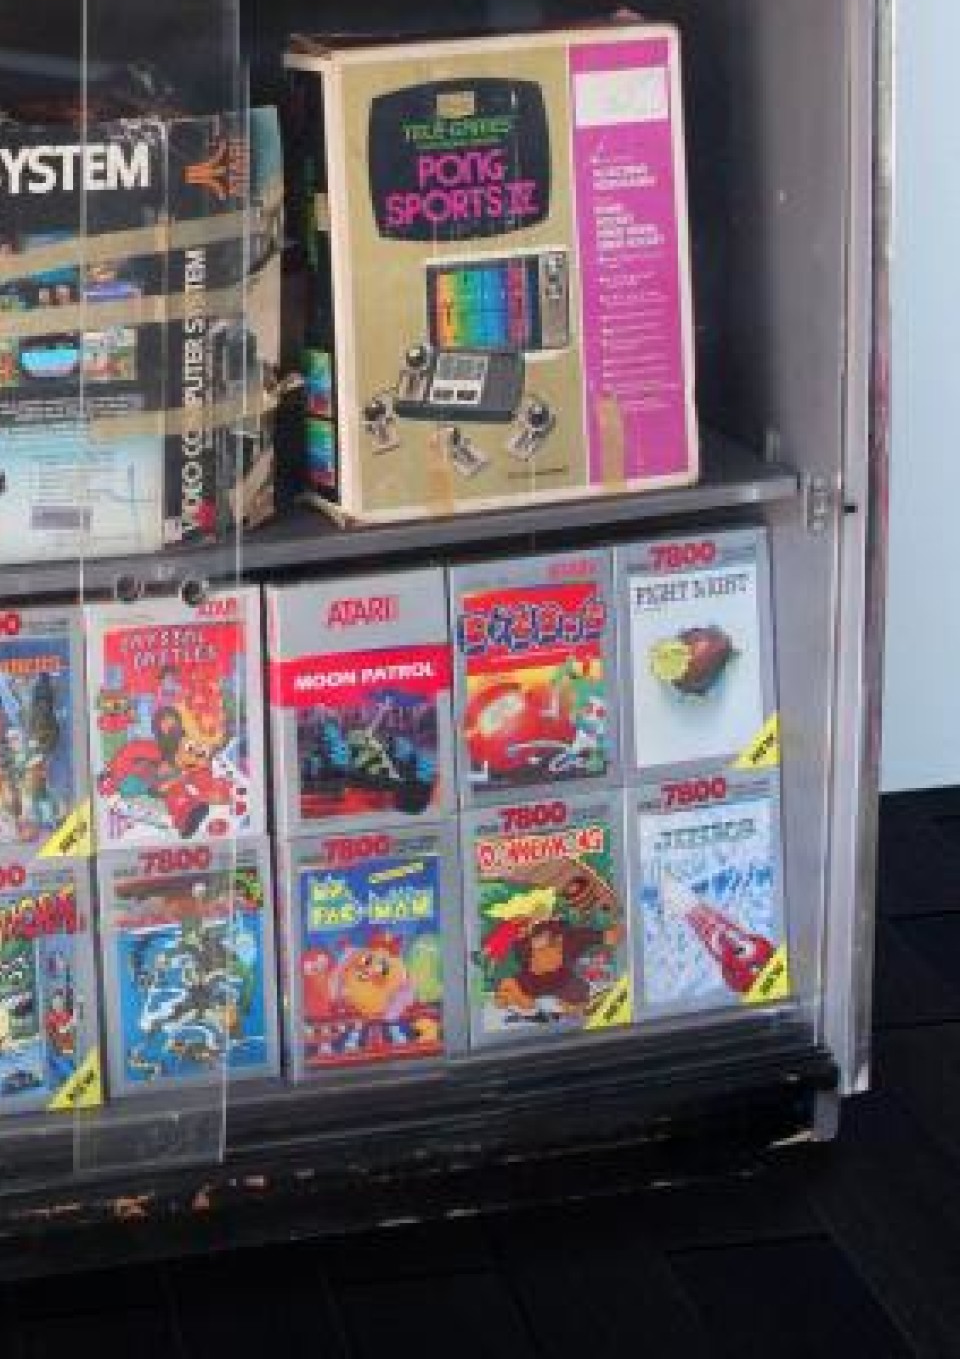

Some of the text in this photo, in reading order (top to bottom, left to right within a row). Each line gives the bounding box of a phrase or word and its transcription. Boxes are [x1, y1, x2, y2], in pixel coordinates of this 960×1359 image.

[419, 149, 508, 190] PONG
[385, 186, 502, 228] SPORTS
[181, 338, 203, 456] COPUTER
[648, 541, 716, 569] 7800
[327, 596, 399, 627] ATARI
[294, 661, 434, 691] MOON PATROL
[661, 778, 727, 807] 7800
[501, 802, 567, 832] 7800
[139, 847, 213, 873] 7800
[322, 836, 392, 864] 7800
